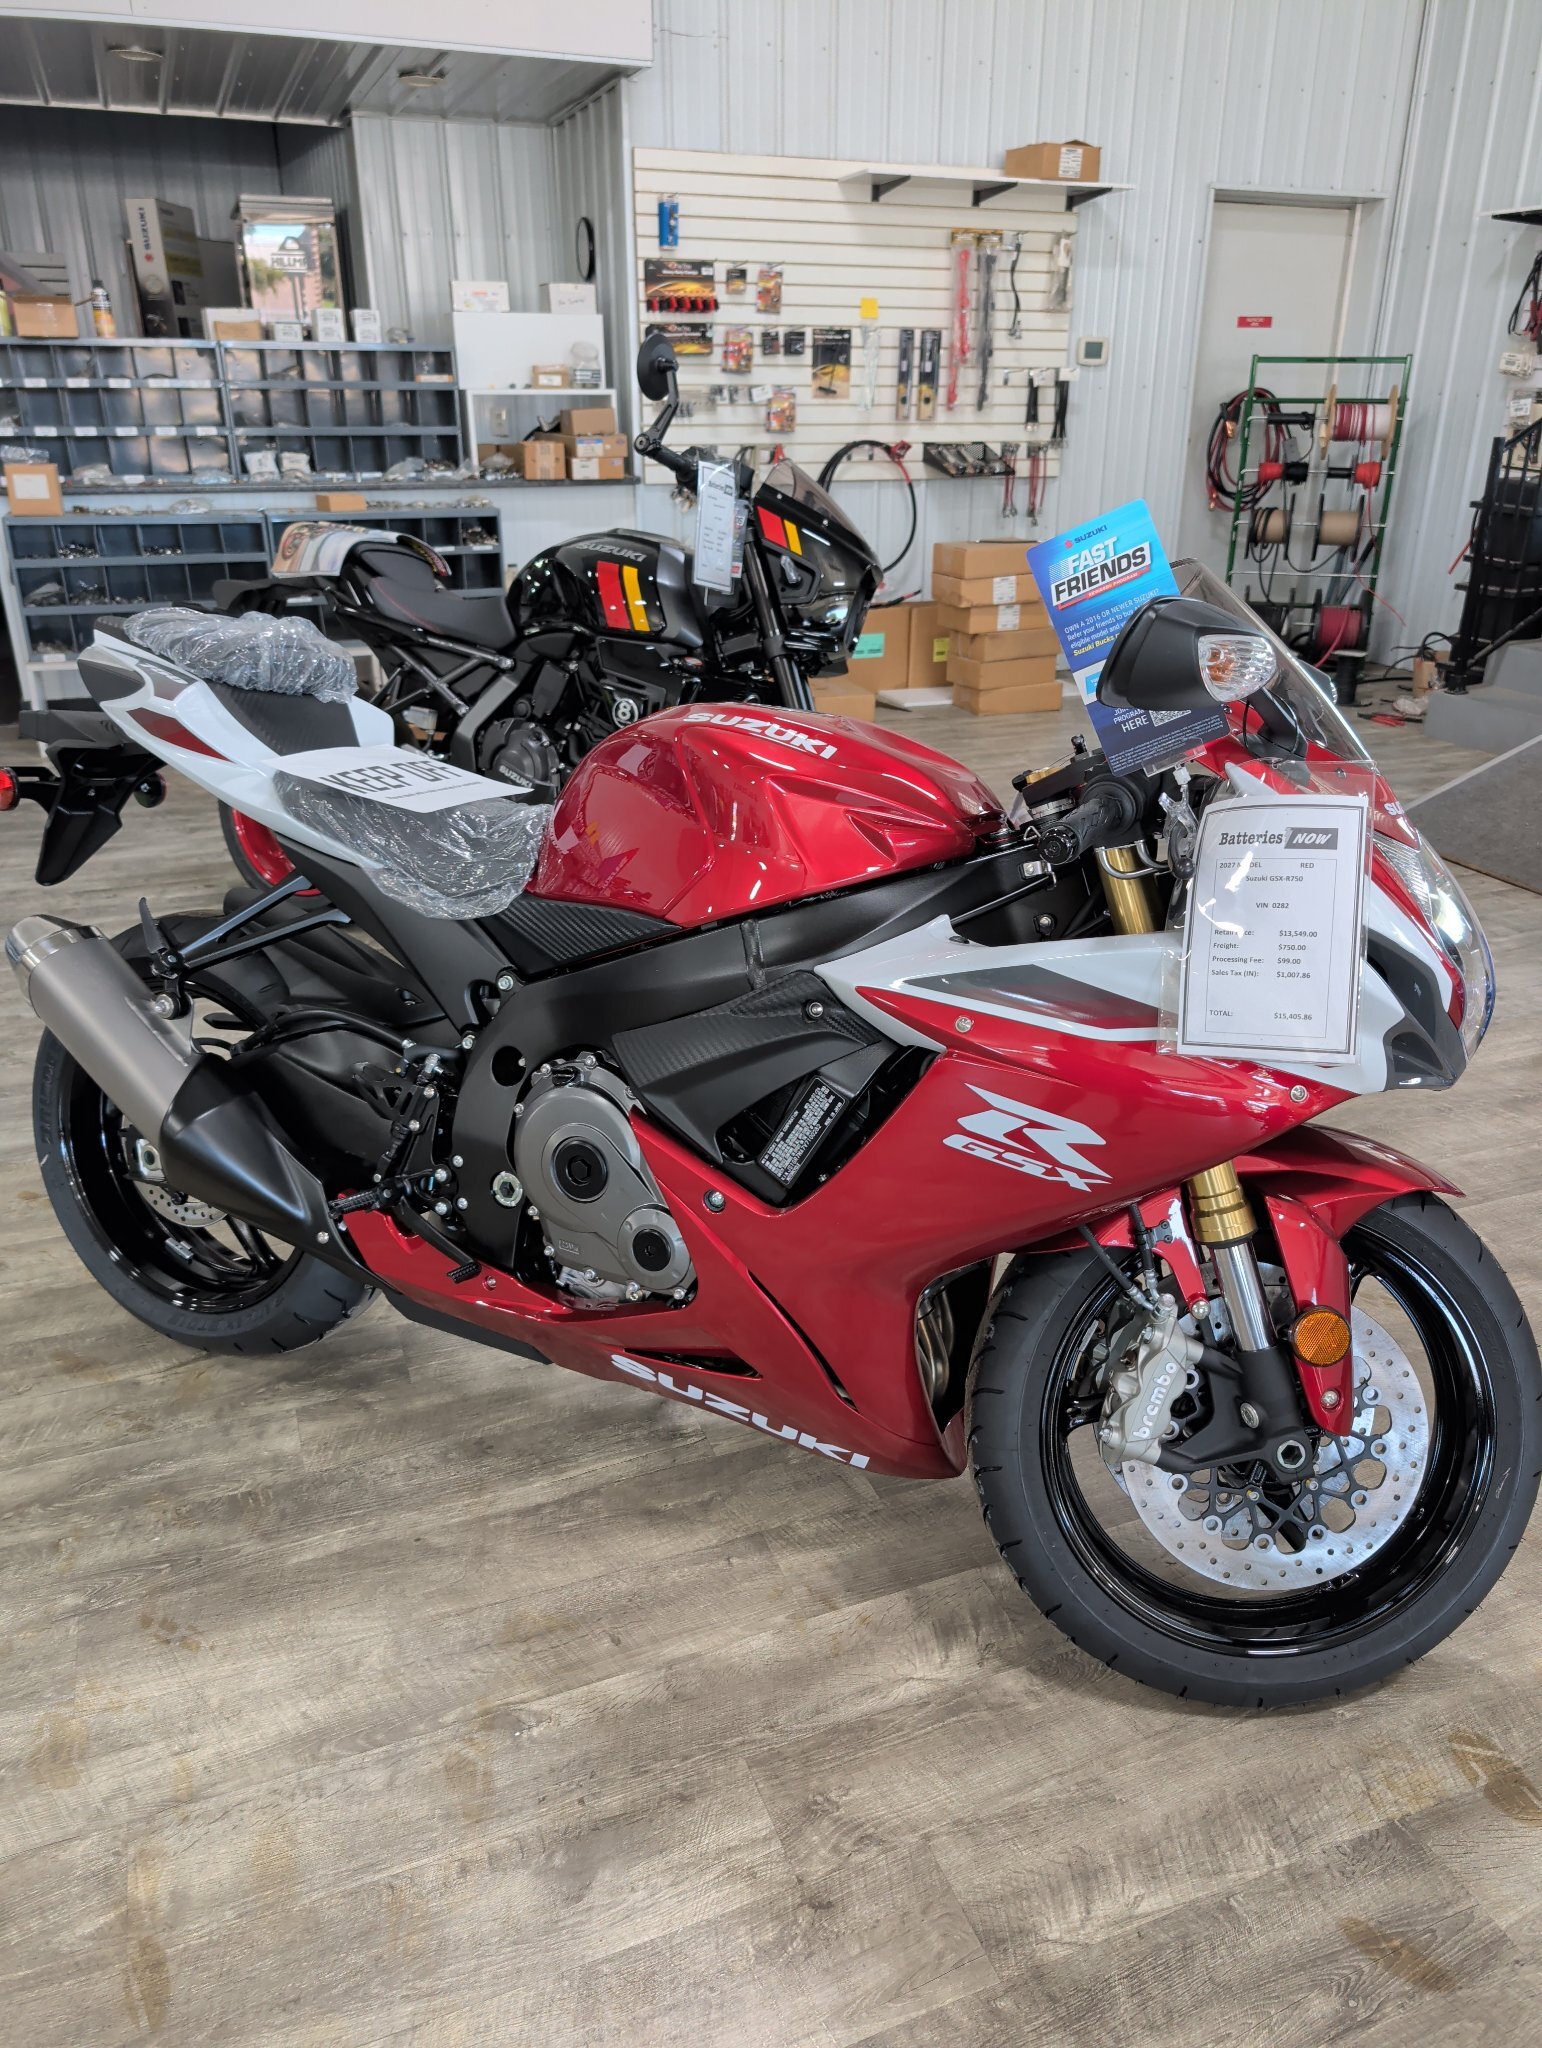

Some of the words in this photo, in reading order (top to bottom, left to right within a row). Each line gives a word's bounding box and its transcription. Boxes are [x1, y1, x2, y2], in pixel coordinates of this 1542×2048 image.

[138, 208, 151, 250] SUZUKI
[1074, 525, 1108, 544] SUZUKI
[576, 543, 647, 562] SUZUKI
[1068, 536, 1117, 574] FAST
[1054, 546, 1146, 602] FRIENDS
[1065, 623, 1079, 634] OWN
[1087, 614, 1101, 625] 2016
[1102, 610, 1110, 618] OR
[1111, 600, 1133, 613] NEWER
[1133, 588, 1159, 603] SUZUKI?
[1067, 631, 1083, 641] Refer
[1083, 626, 1096, 636] your
[1096, 618, 1116, 630] friends
[1070, 636, 1090, 649] eligible
[1091, 629, 1109, 641] model
[1109, 623, 1120, 633] and
[1073, 643, 1094, 656] Suzuki
[1095, 634, 1115, 647] Bucks
[616, 700, 631, 720] 8
[1121, 715, 1149, 732] HERE
[684, 713, 838, 759] SUZUKI
[318, 766, 413, 794] KEEP
[390, 760, 463, 782] OFF
[499, 765, 533, 788] SUZUKI
[1219, 830, 1284, 845] Batteries
[1293, 833, 1332, 845] NOW
[1279, 930, 1318, 938] $13,549.00
[1212, 956, 1248, 964] Processing
[1277, 957, 1301, 965] $99.00
[1276, 971, 1311, 979] $1,007.86
[1273, 1012, 1312, 1020] $15,405.86
[943, 1134, 1112, 1192] GSX
[611, 1354, 870, 1469] SUZUKI
[1133, 1362, 1177, 1438] brembo
